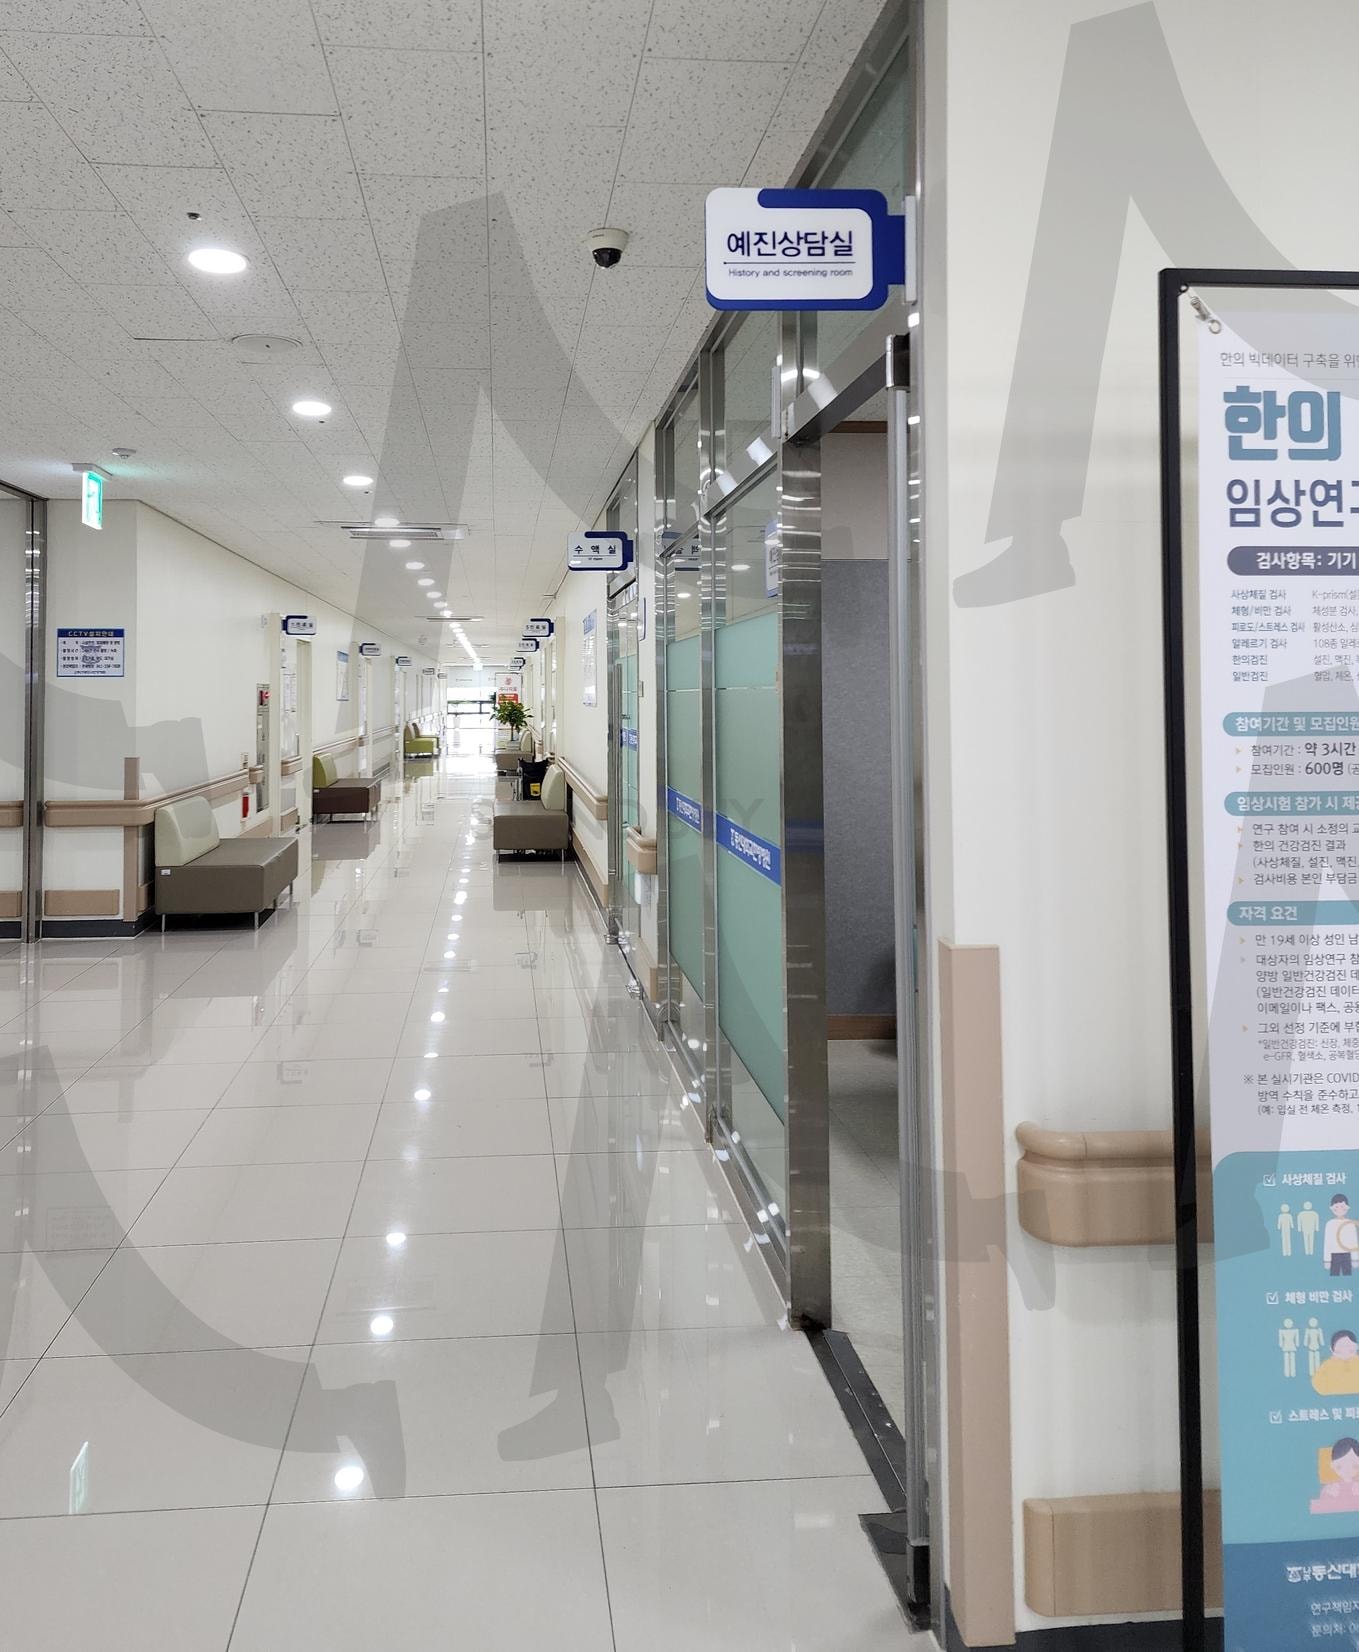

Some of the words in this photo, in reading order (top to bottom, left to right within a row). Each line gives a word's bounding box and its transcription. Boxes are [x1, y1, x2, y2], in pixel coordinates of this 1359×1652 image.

[727, 230, 853, 257] 예진상담실
[728, 268, 760, 278] History
[763, 268, 780, 277] and
[783, 268, 828, 278] screening
[1249, 352, 1299, 368] 빅데이터
[1303, 352, 1339, 368] 구축을
[1223, 385, 1341, 461] 한의
[1256, 552, 1322, 570] 검사항목:
[1327, 552, 1357, 570] 기기
[1270, 589, 1287, 600] 검사
[1274, 606, 1292, 617] 검사
[1290, 622, 1305, 632] 검사
[1270, 638, 1287, 649] 검사
[1235, 716, 1289, 731] 참여기간
[1293, 716, 1306, 731] 및
[1251, 744, 1294, 757] 참여기간
[1305, 742, 1317, 756] 약
[1321, 741, 1356, 756] 3시간
[1251, 763, 1295, 776] 모집인원
[1305, 761, 1344, 776] 600명
[1237, 796, 1291, 812] 임상시험
[1295, 796, 1322, 812] 참가
[1325, 796, 1338, 811] 시
[1253, 823, 1275, 836] 연구
[1278, 823, 1299, 836] 참여
[1303, 823, 1313, 835] 시
[1317, 823, 1349, 836] 소정의
[1253, 840, 1274, 852] 한의
[1278, 840, 1322, 852] 건강검진
[1325, 839, 1346, 852] 결과
[1253, 856, 1305, 869] (사상체질,
[1308, 856, 1333, 869] 설진,
[1254, 873, 1298, 886] 검사비용
[1301, 872, 1322, 885] 본인
[1326, 872, 1358, 885] 부담금
[1239, 906, 1266, 921] 자격
[1270, 906, 1298, 921] 요건
[1255, 934, 1266, 947] 만
[1271, 934, 1295, 946] 19세
[1299, 934, 1320, 946] 이상
[1324, 933, 1345, 946] 성인
[1256, 954, 1300, 966] 대상자의
[1303, 953, 1346, 966] 임상연구
[1256, 970, 1278, 983] 양방
[1282, 970, 1346, 983] 일반건강검진
[1256, 986, 1327, 999] (일반건강검진
[1257, 1002, 1312, 1015] 이메일이나
[1316, 1002, 1340, 1014] 팩스,
[1283, 1022, 1305, 1034] 선정
[1308, 1022, 1340, 1034] 기준에
[1257, 1073, 1268, 1085] 본
[1271, 1073, 1324, 1085] 실시기관은
[1257, 1090, 1279, 1102] 방역
[1283, 1090, 1313, 1102] 수칙을
[1318, 1089, 1359, 1101] 준수하고
[1277, 1104, 1296, 1115] 입실
[1300, 1104, 1308, 1115] 전
[1311, 1103, 1329, 1115] 체온
[1282, 1172, 1324, 1186] 사상체질
[1326, 1171, 1346, 1185] 검사
[1285, 1291, 1306, 1304] 체형
[1309, 1290, 1329, 1303] 비만
[1332, 1289, 1353, 1303] 검사
[1288, 1408, 1330, 1421] 스트레스
